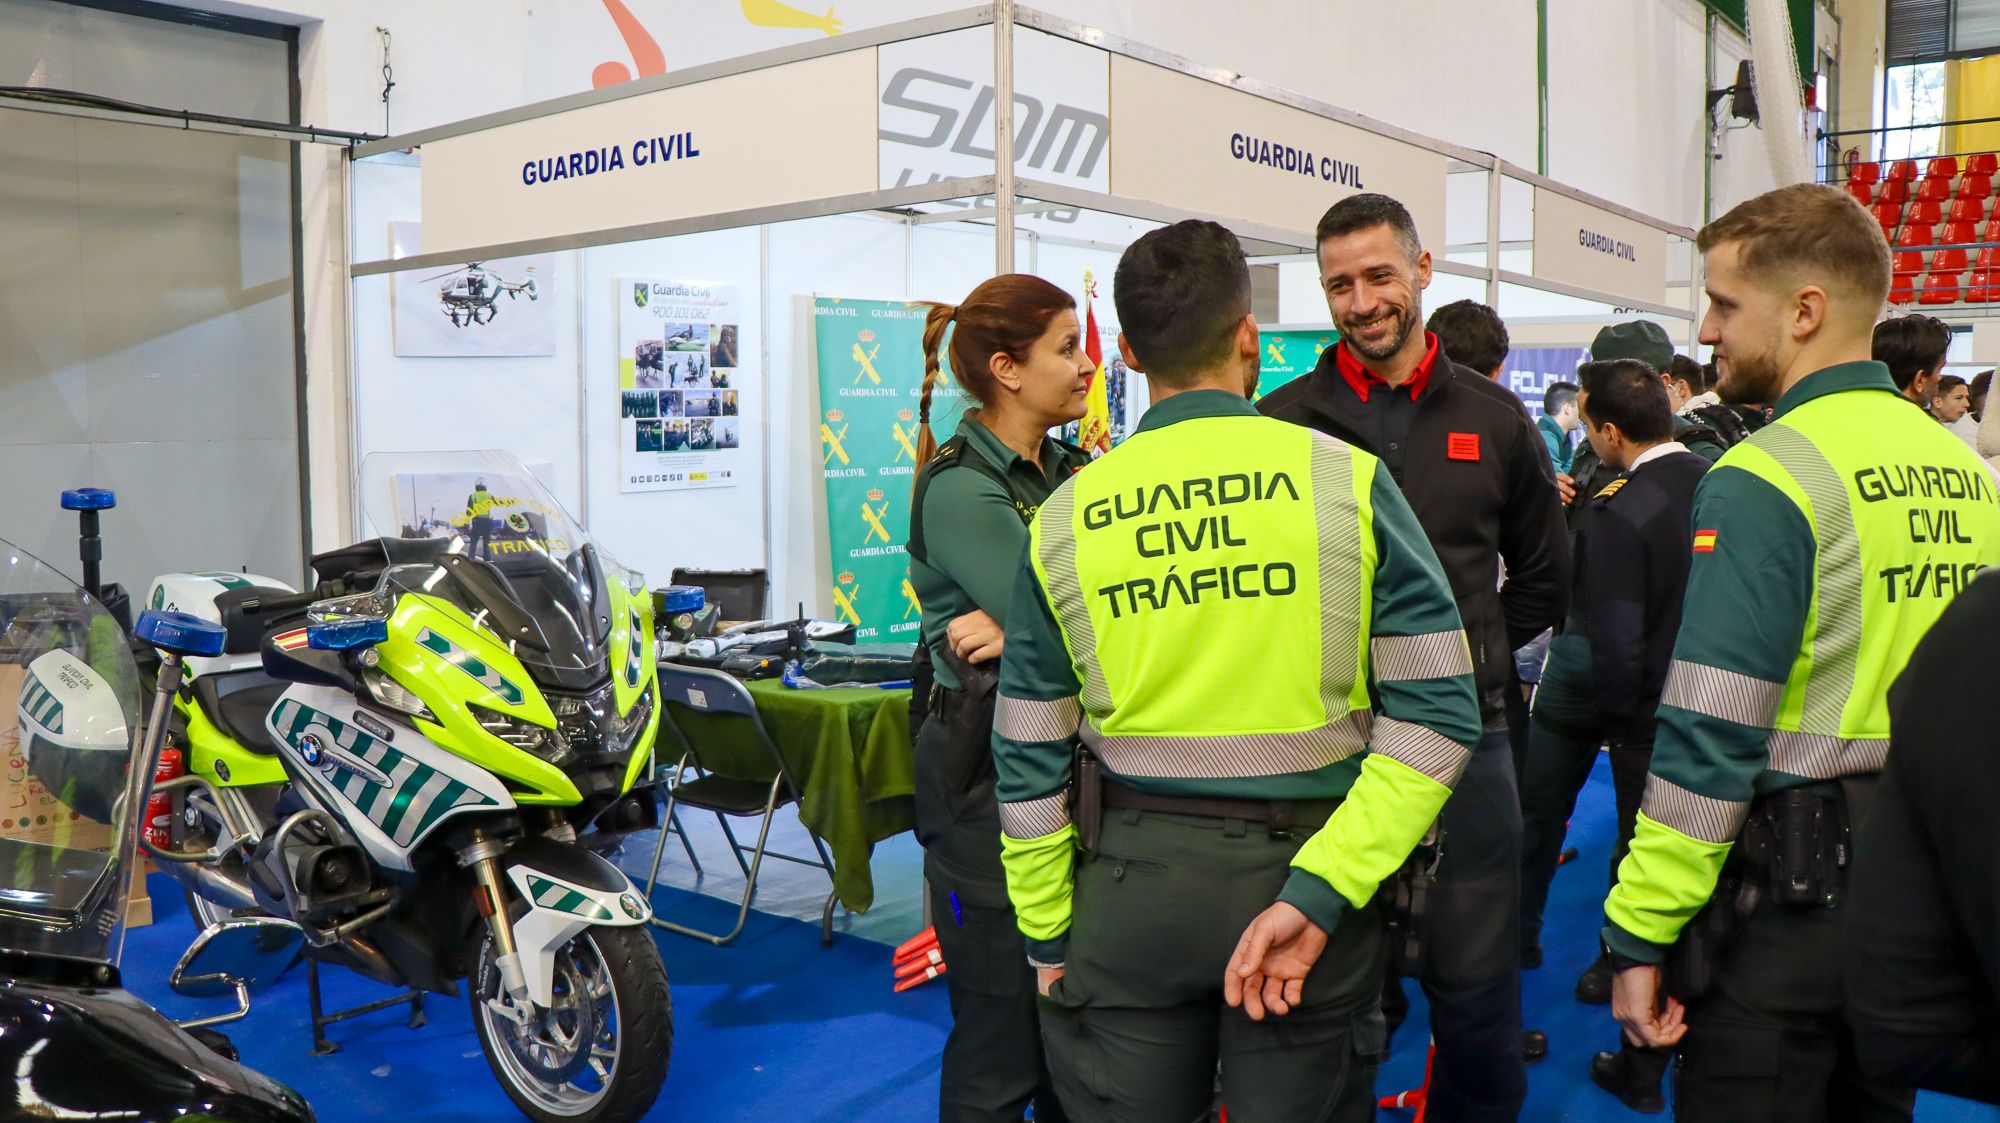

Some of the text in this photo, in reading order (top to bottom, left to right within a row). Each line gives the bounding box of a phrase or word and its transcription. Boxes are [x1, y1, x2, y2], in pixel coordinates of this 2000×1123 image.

[522, 131, 700, 186] GUARDIA CIVIL
[1230, 133, 1364, 190] GUARDIA CIVIL
[1579, 228, 1636, 262] GUARDIA CIVIL
[653, 283, 710, 297] Guardia Civil
[653, 305, 710, 320] 900 101 062
[814, 306, 859, 317] RDIA CIVIL
[871, 309, 907, 319] GUARDIA
[840, 387, 898, 397] GUARDIA CIVIL
[845, 467, 867, 477] CIVIL
[880, 466, 914, 476] GUARDIA
[1854, 464, 1993, 503] GUARDIA
[1083, 471, 1300, 531] GUARDIA
[1136, 515, 1247, 558] CIVIL
[1908, 508, 1972, 544] CIVIL
[850, 544, 907, 558] GUARDIA CIVIL
[1879, 554, 1989, 603] TRÁFIC
[1098, 564, 1296, 619] TRÁFICO
[856, 627, 878, 638] CIVIL
